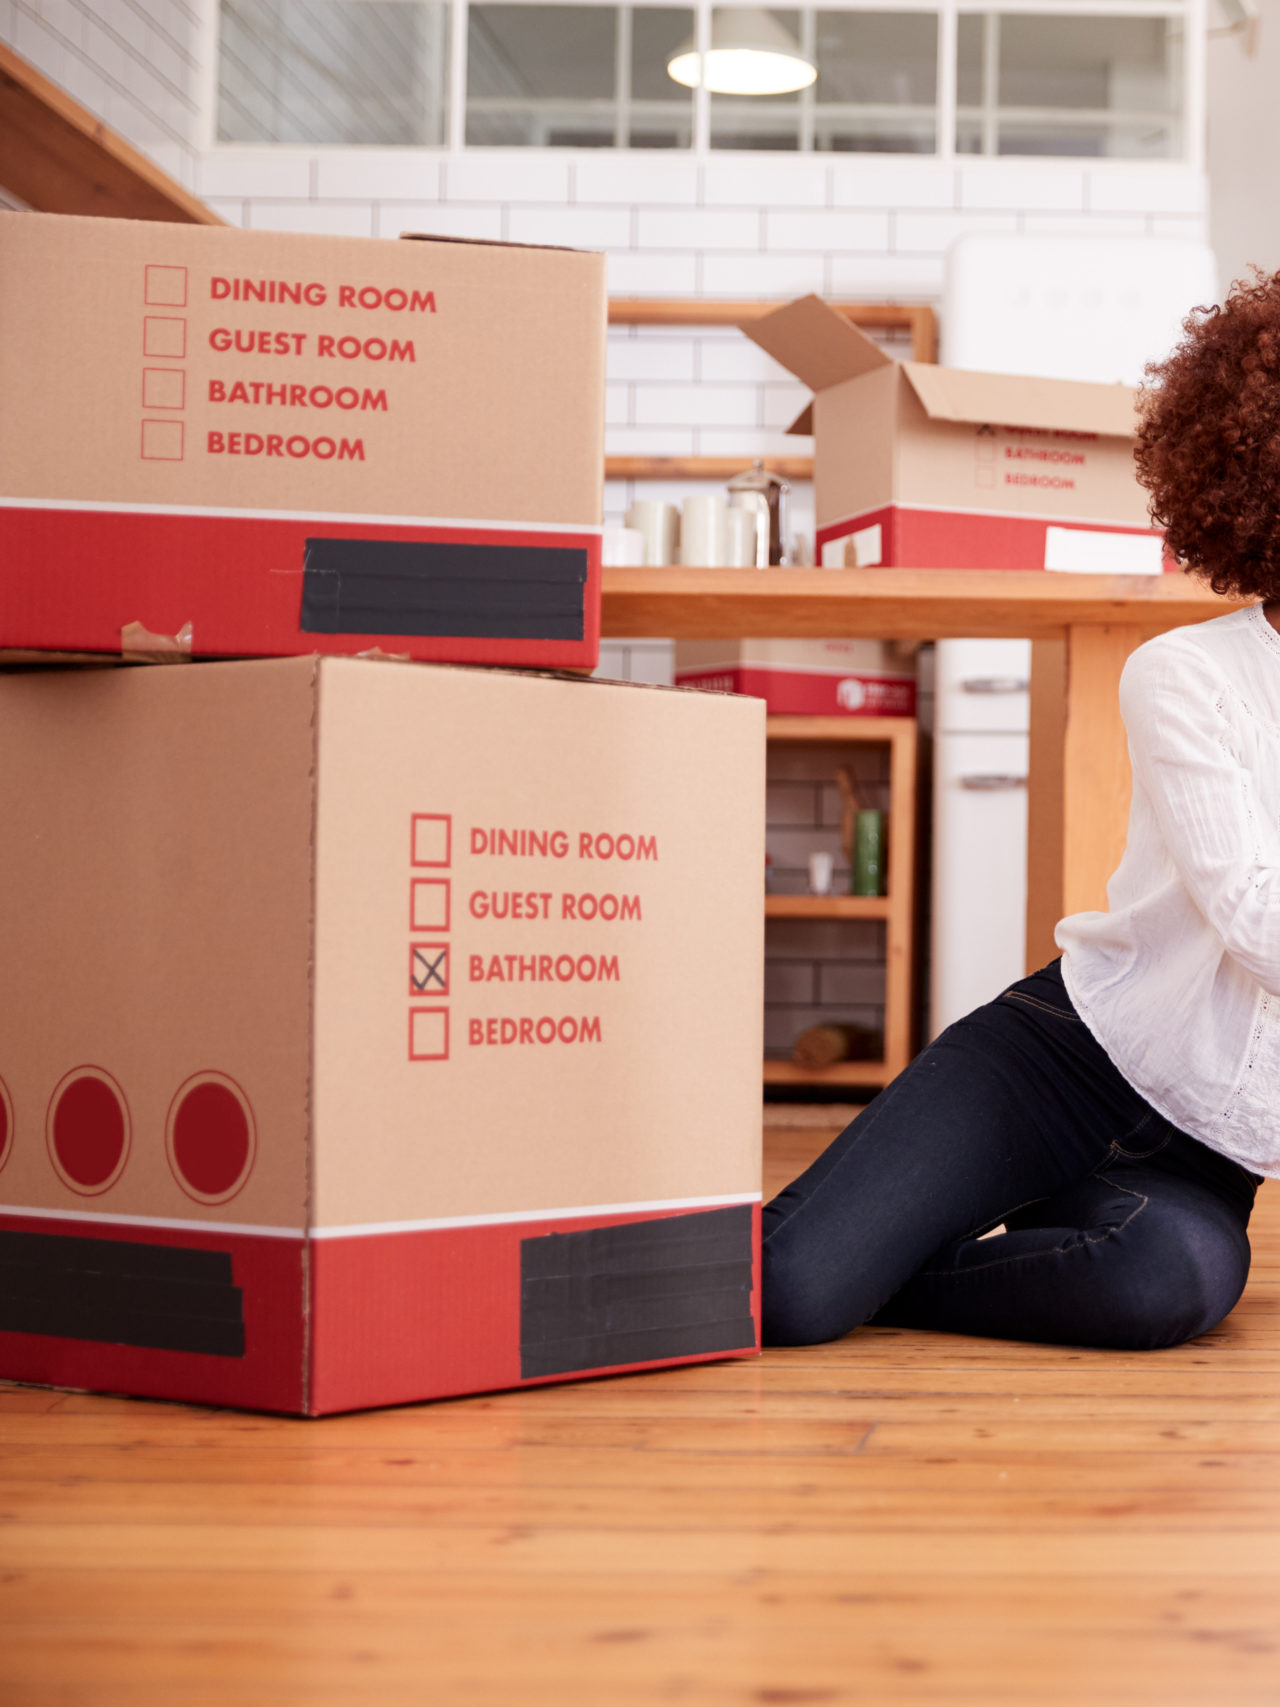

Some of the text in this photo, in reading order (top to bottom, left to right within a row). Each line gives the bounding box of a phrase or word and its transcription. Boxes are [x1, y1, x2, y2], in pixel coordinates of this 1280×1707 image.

[210, 276, 437, 313] DINING ROOM
[208, 327, 417, 363] GUEST ROOM
[208, 379, 389, 412] BATHROOM
[207, 431, 366, 461] BEDROOM
[1004, 447, 1085, 465] BATHROOM
[1004, 472, 1076, 489] BEDROOM
[470, 827, 658, 861] DINING ROOM
[468, 890, 642, 921] GUEST ROOM
[468, 954, 621, 982] BATHROOM
[468, 1016, 602, 1045] BEDROOM
